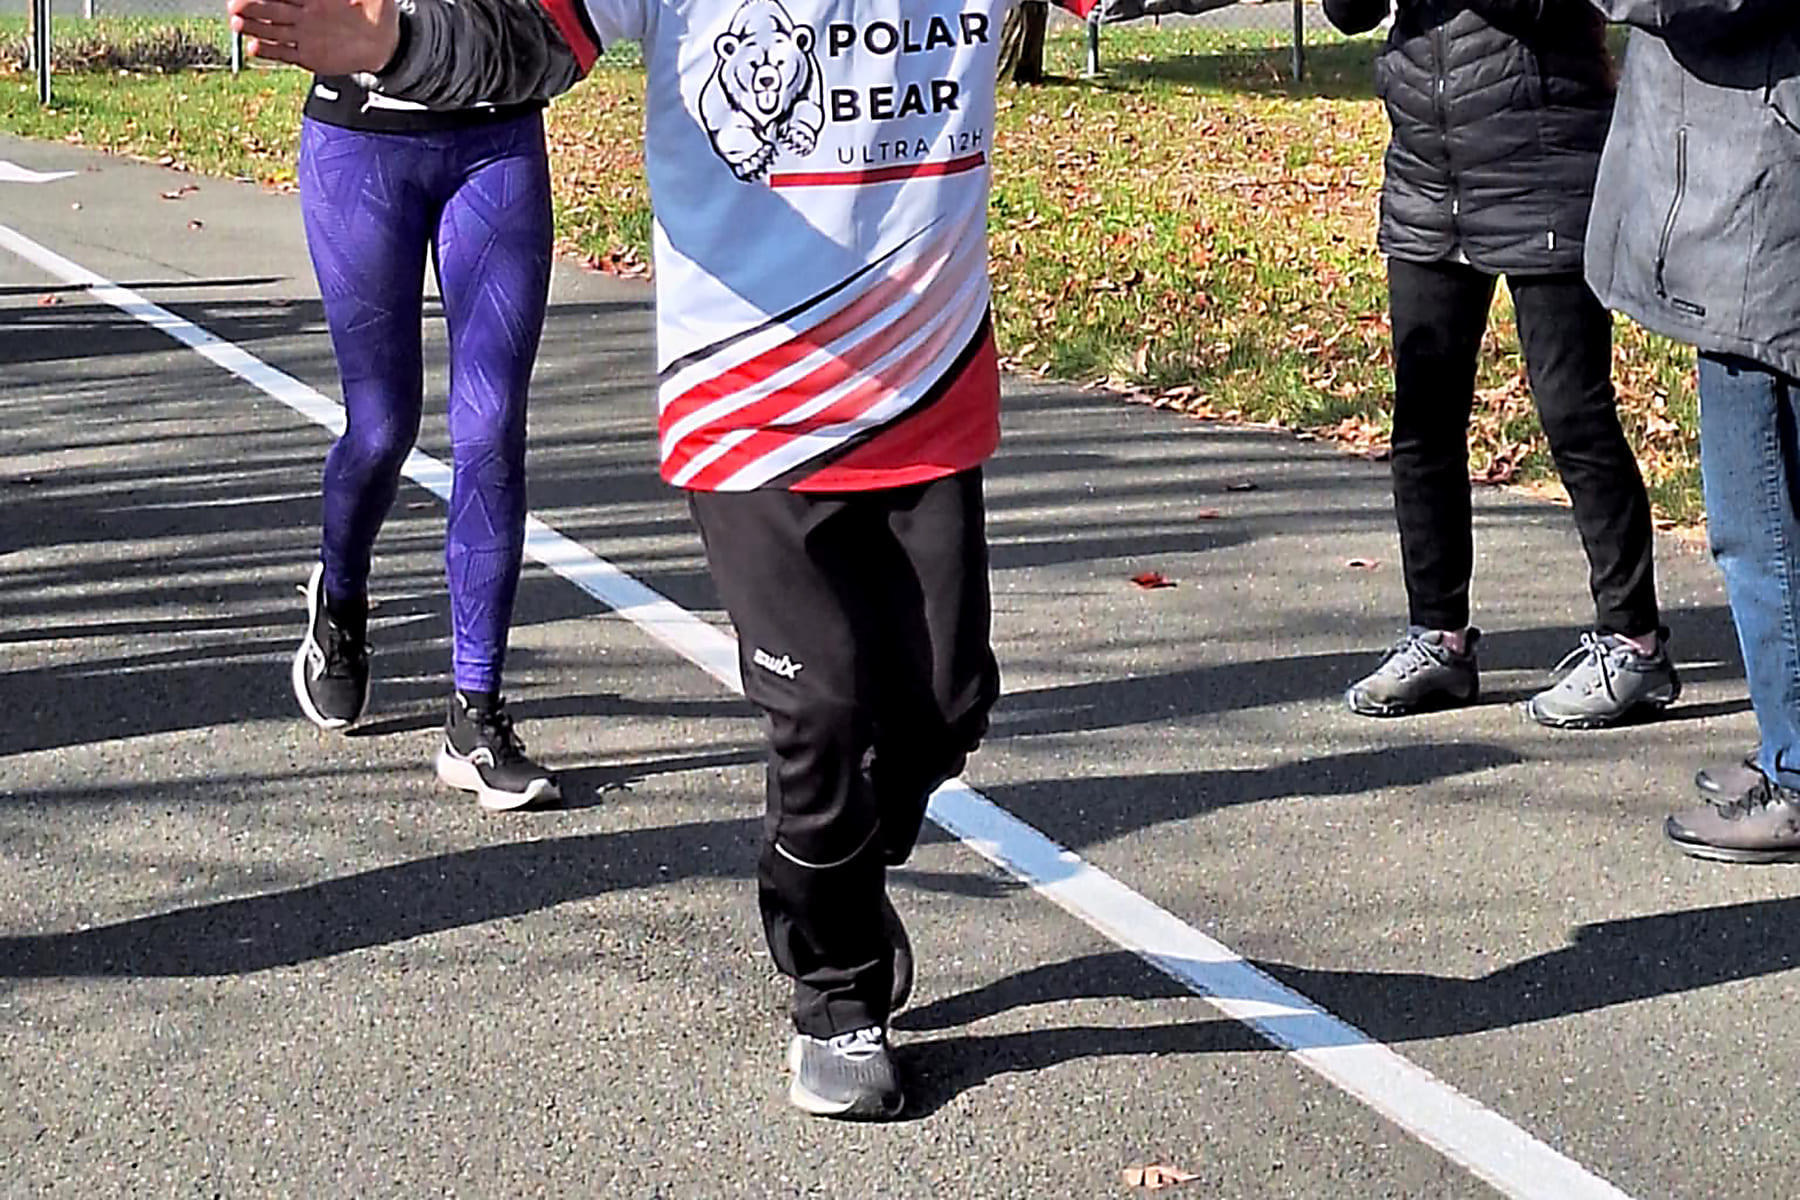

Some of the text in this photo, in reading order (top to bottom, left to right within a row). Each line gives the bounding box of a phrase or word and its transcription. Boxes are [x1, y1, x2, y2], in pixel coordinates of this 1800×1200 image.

[829, 12, 989, 57] POLAR
[831, 80, 959, 122] BEAR
[838, 128, 983, 164] ULTRA 12H
